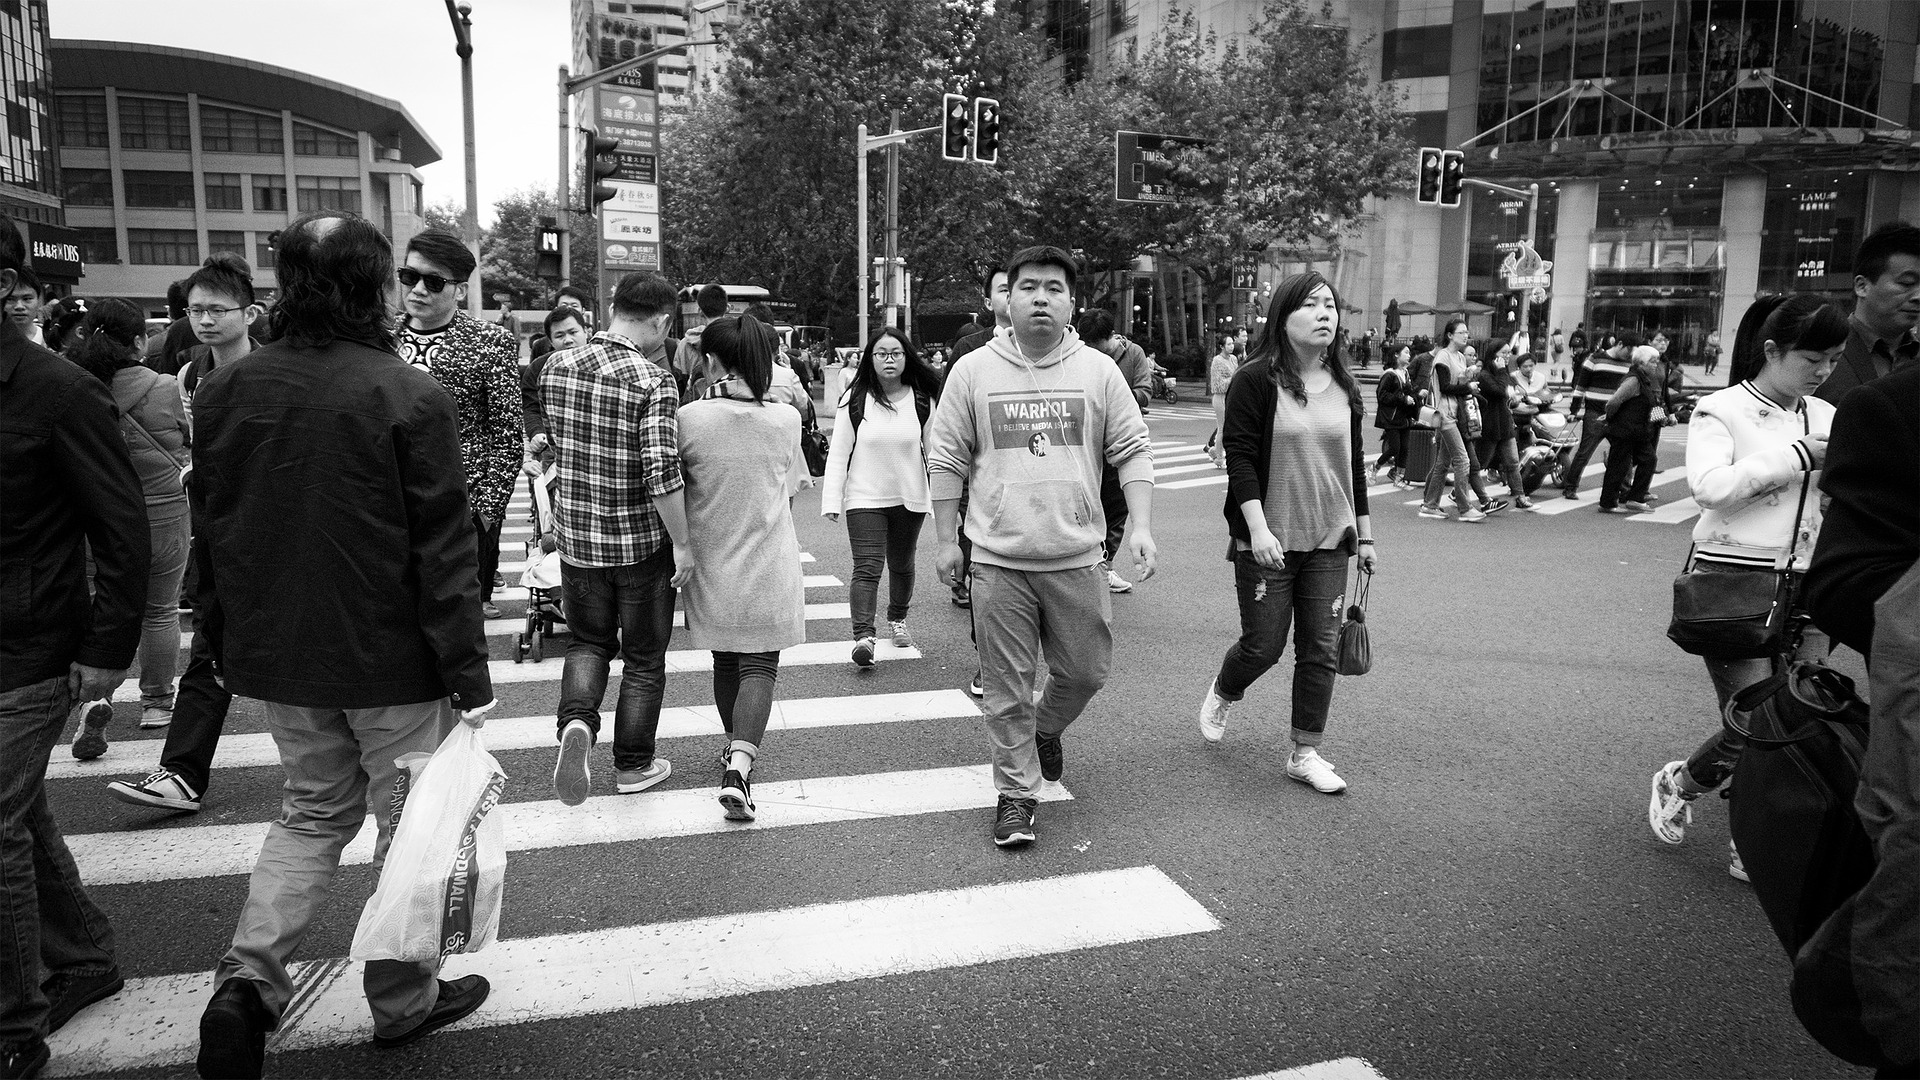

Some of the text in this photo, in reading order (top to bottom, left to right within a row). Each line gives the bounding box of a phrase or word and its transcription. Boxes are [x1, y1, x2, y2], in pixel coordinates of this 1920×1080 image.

[63, 243, 80, 262] DBS
[1003, 401, 1071, 420] WARHOL
[1003, 422, 1031, 432] BELIEVE
[1031, 421, 1053, 431] MEDIA
